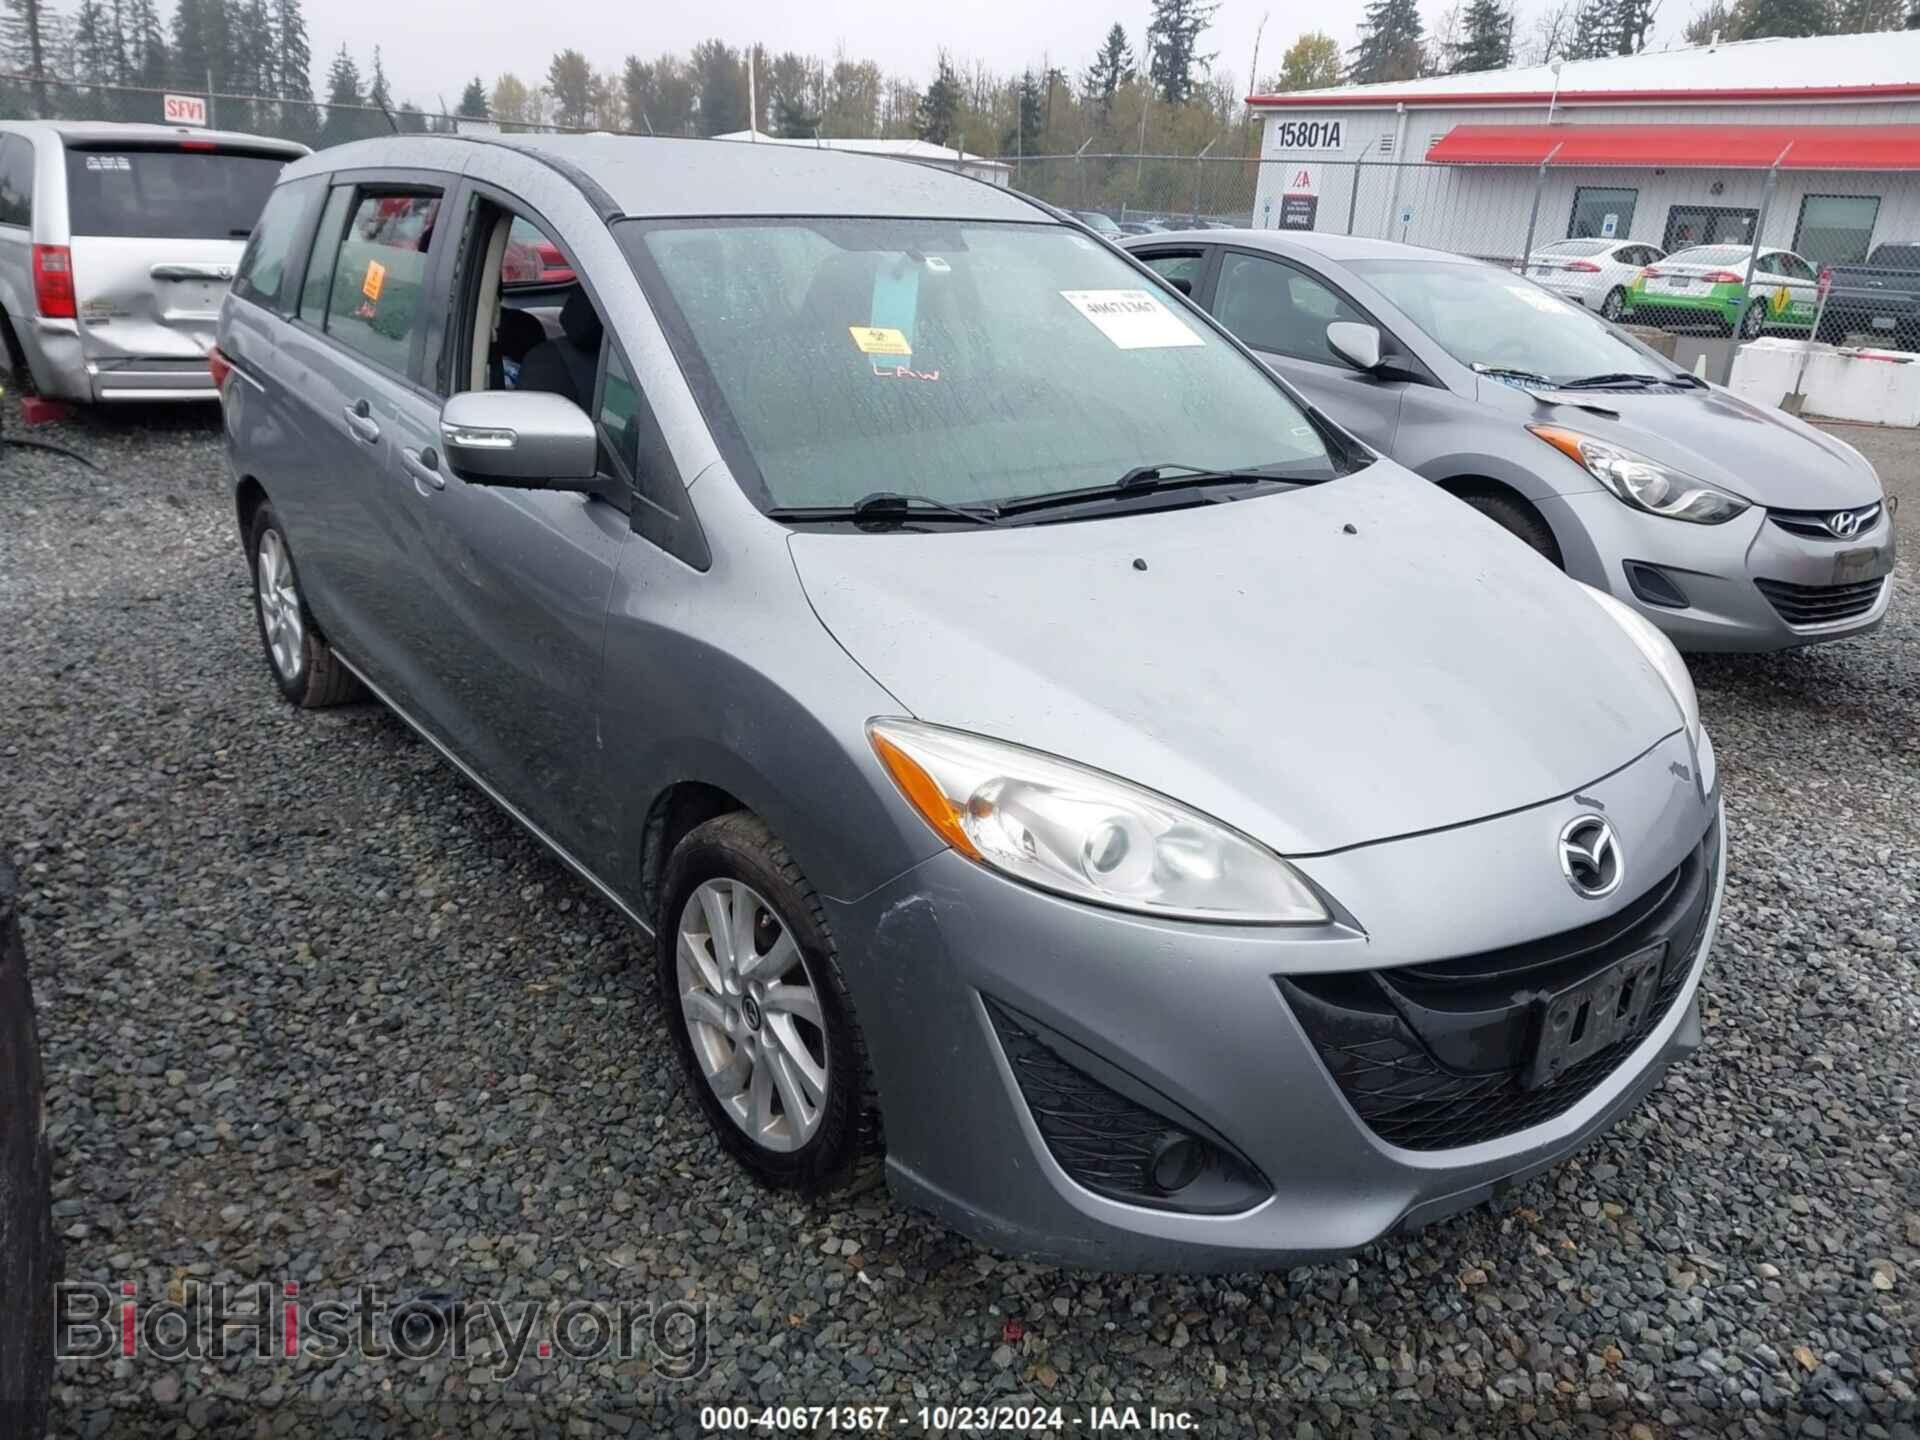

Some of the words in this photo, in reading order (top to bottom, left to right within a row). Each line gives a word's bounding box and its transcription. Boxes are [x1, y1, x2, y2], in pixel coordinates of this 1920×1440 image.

[167, 99, 203, 120] SFV1
[1278, 121, 1341, 148] 15801A
[873, 361, 939, 381] LAW
